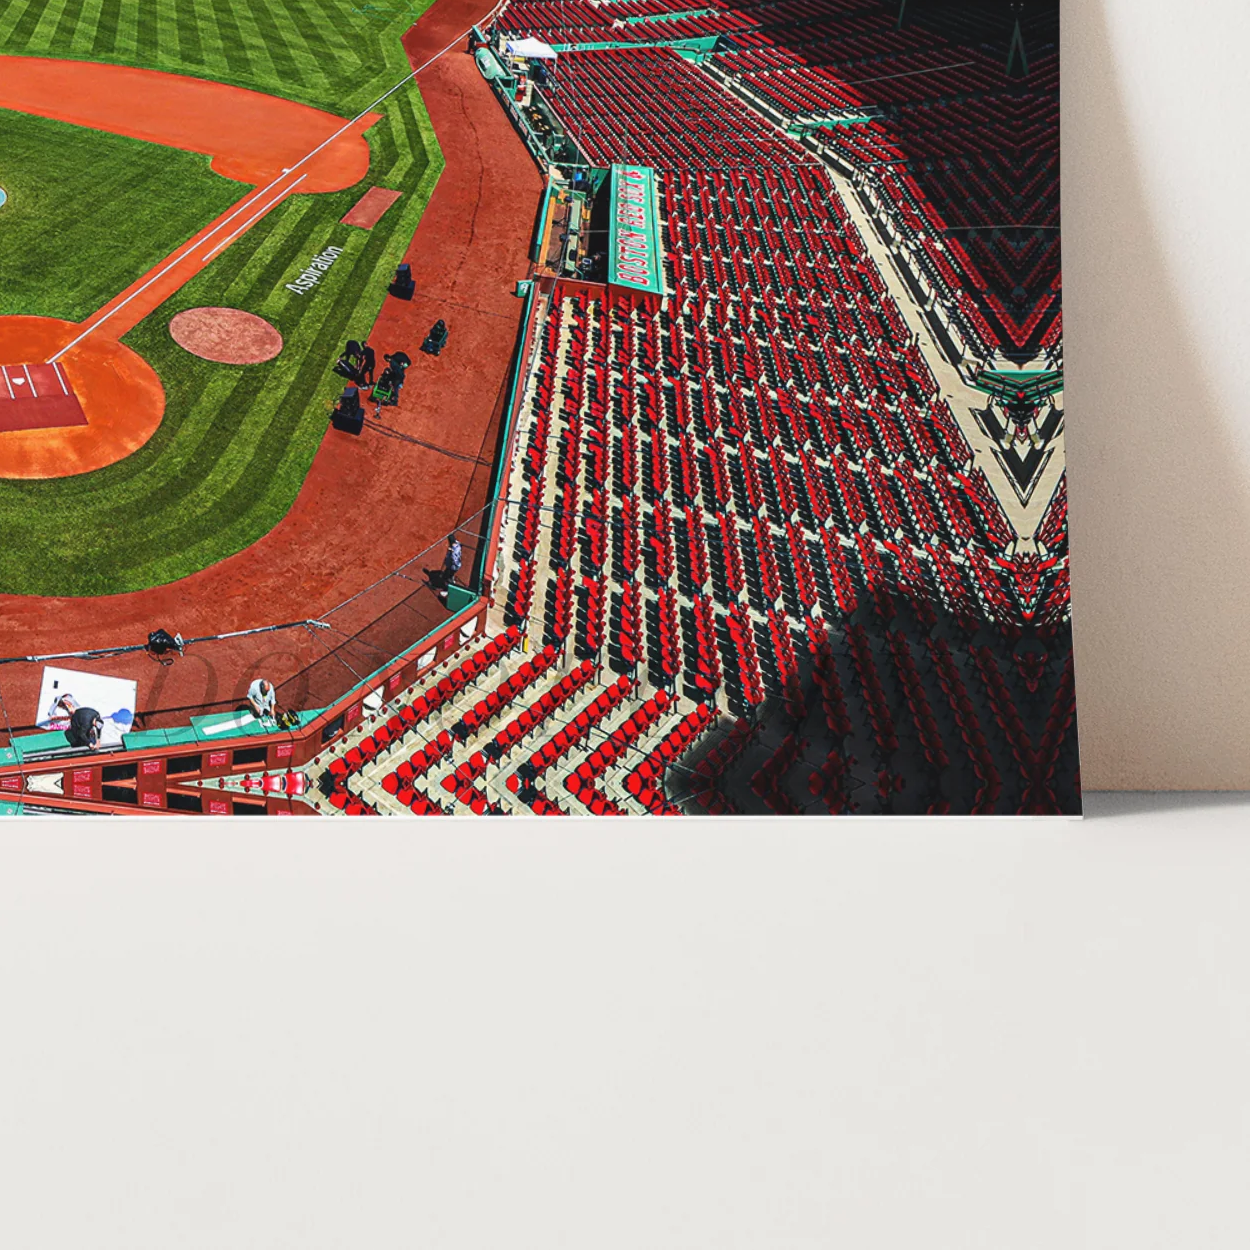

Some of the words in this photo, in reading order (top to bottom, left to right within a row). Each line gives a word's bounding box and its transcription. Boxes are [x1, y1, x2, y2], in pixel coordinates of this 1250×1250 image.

[619, 178, 646, 203] SOX
[616, 202, 646, 229] RED
[285, 245, 344, 295] Aspiration
[617, 229, 650, 287] BOSTON
